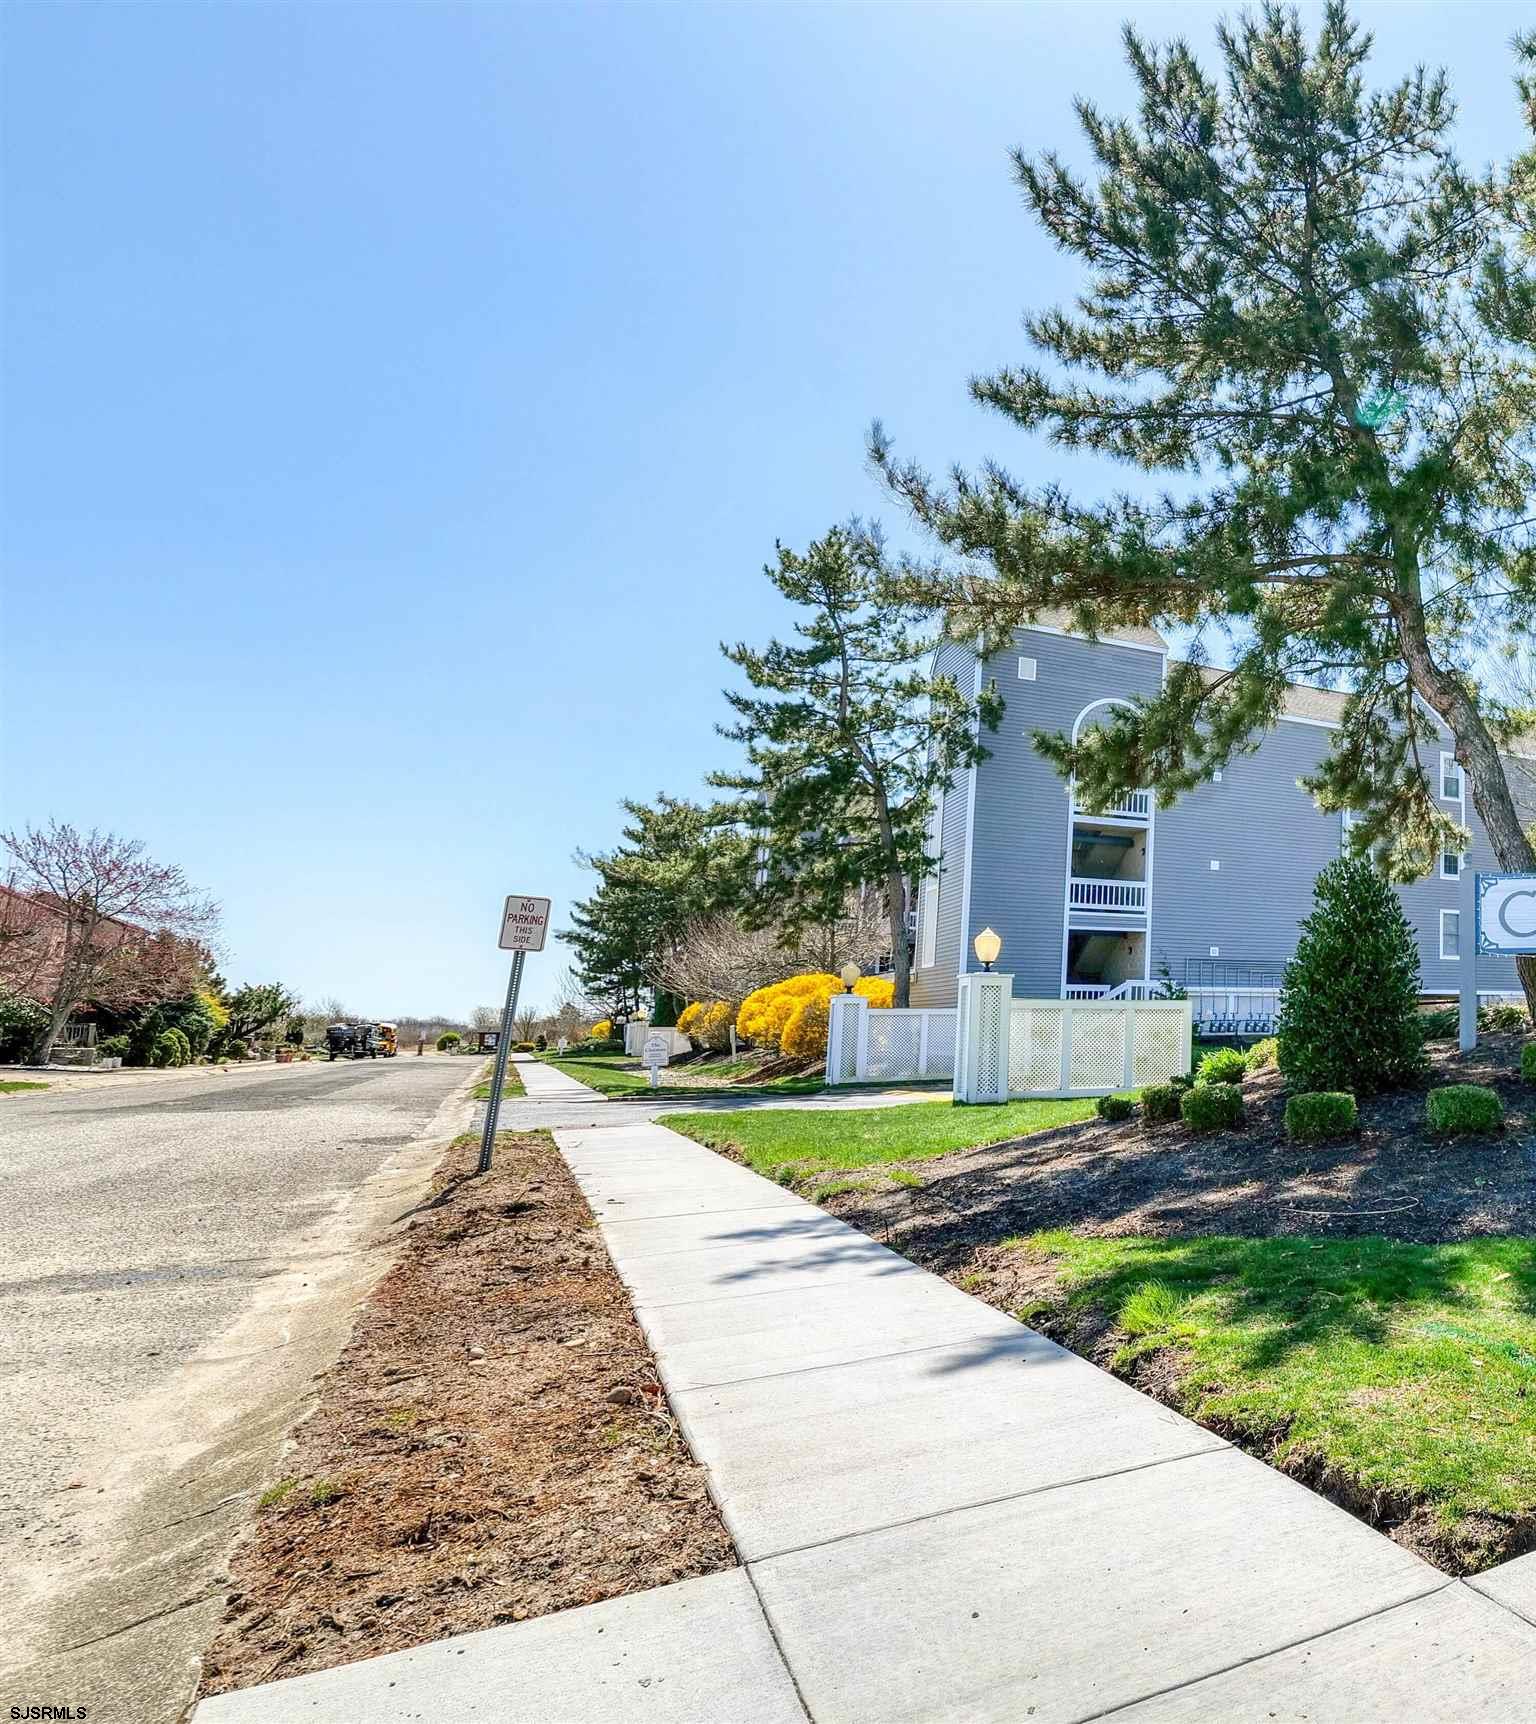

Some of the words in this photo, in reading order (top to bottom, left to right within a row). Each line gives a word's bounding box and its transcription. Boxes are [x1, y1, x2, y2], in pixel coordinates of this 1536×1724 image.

[520, 902, 535, 913] NO
[507, 913, 544, 926] PARKING
[515, 926, 534, 935] THIS
[513, 935, 531, 944] SIDE
